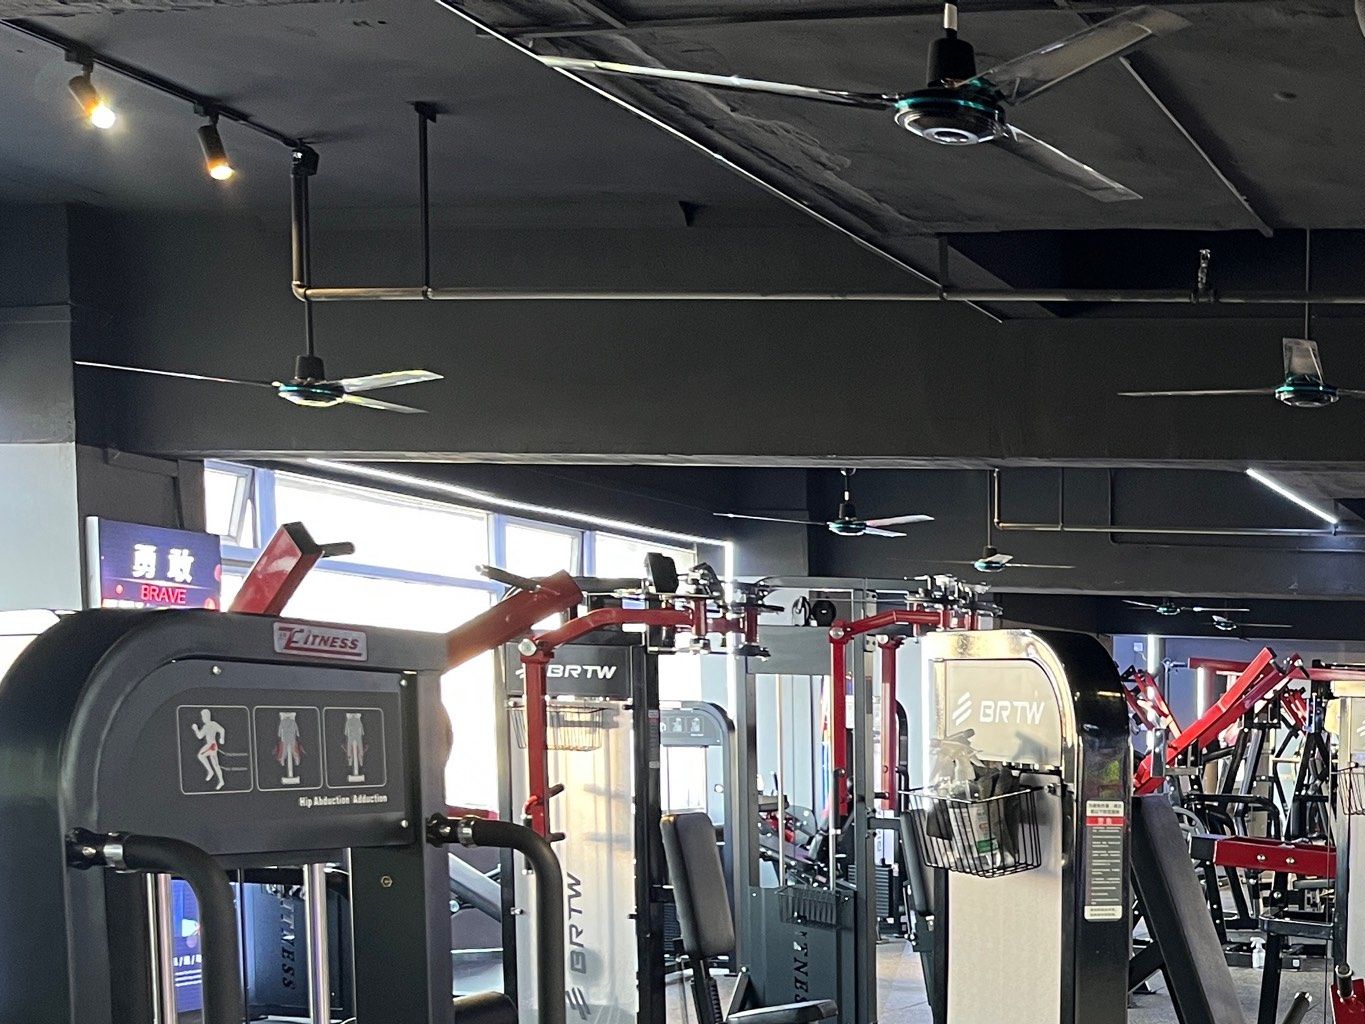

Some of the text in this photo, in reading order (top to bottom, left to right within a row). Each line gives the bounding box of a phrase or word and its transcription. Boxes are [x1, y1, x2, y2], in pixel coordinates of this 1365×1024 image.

[132, 543, 194, 583] 勇敢
[140, 584, 187, 605] BRAVE
[546, 664, 617, 679] BRTW
[979, 700, 1045, 725] BRTW
[299, 793, 388, 809] Hip Abduction Adduction
[566, 871, 587, 975] BRTW
